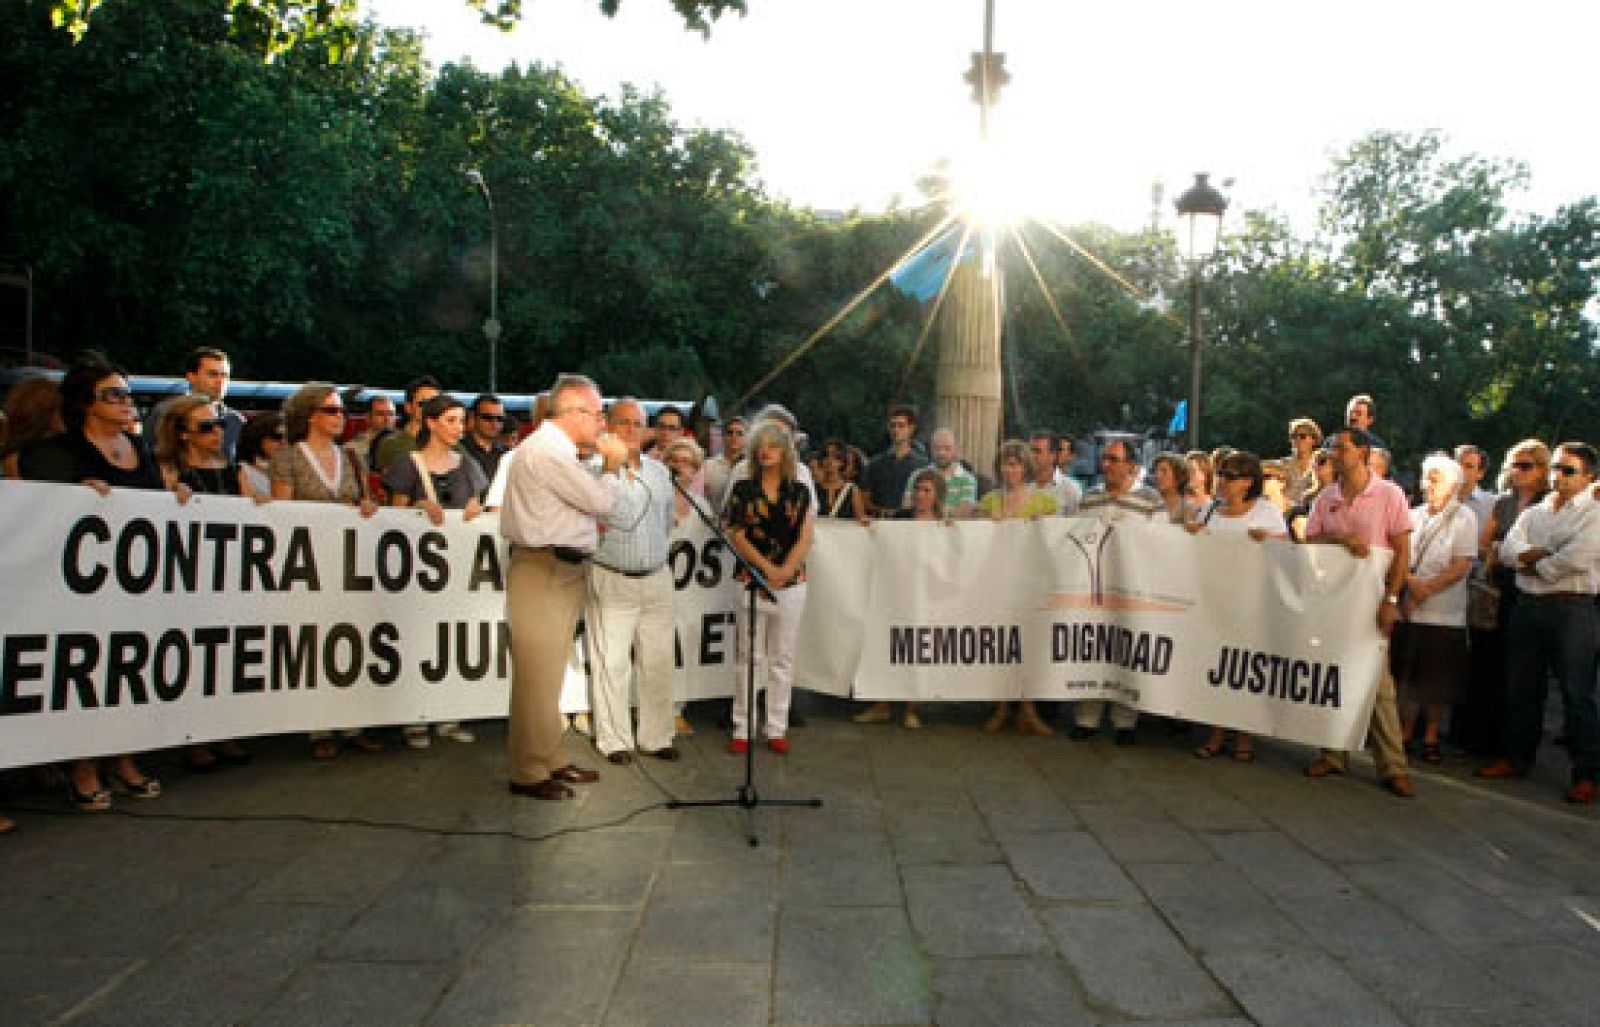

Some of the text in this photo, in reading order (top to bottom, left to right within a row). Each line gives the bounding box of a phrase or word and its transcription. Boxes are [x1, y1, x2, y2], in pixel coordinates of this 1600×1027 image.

[61, 514, 321, 595] CONTRA
[342, 528, 450, 593] LOS
[0, 621, 401, 716] ERROTEMOS
[889, 622, 1342, 708] MEMORIA DIGNIDAD JUSTICIA
